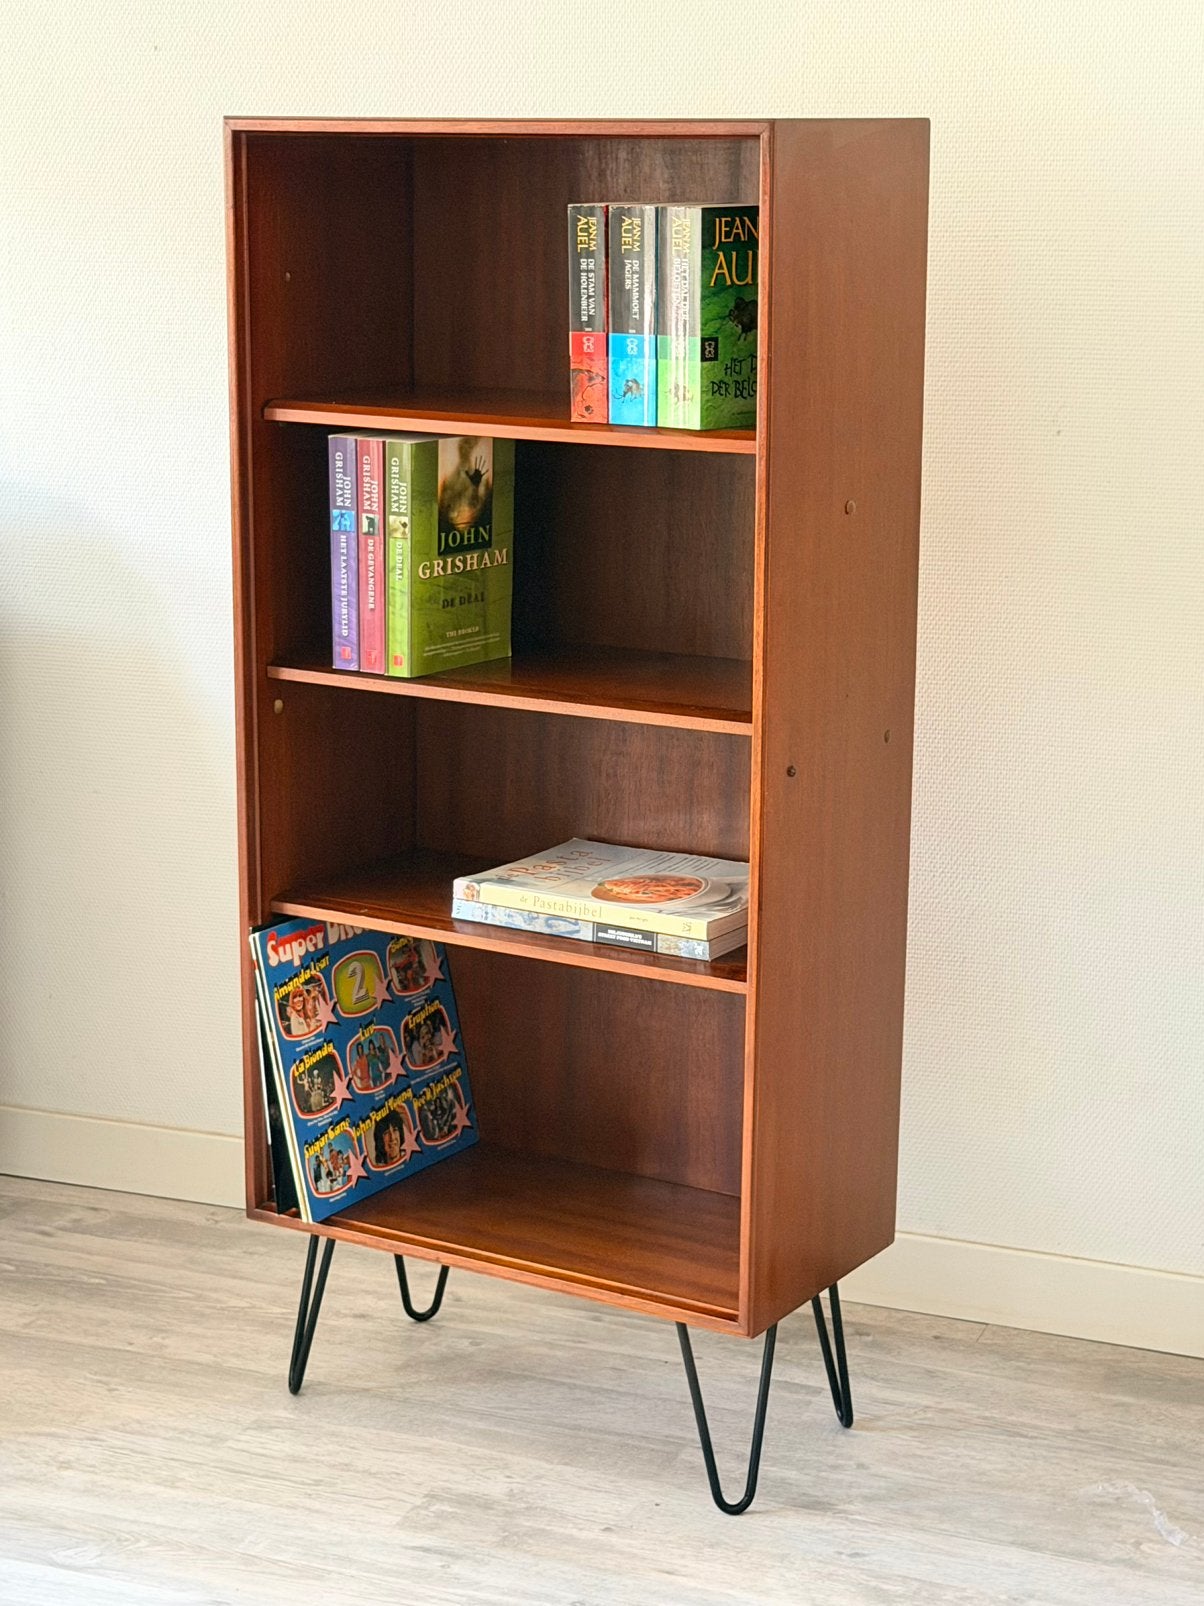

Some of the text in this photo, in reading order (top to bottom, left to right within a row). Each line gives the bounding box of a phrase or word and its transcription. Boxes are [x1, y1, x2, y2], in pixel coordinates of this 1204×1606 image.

[577, 215, 588, 253] AUEL
[587, 216, 597, 251] JEAN M
[621, 215, 632, 254] AUEL
[631, 217, 641, 252] JEAN M
[671, 216, 682, 254] AUEL
[682, 218, 691, 241] JEAN
[588, 258, 595, 270] DE
[624, 260, 632, 290] JAGERS
[580, 258, 588, 322] DE HOLENBEER
[588, 298, 596, 316] VAN
[632, 260, 640, 320] DE MAMMOET
[724, 357, 744, 377] HET
[710, 380, 731, 397] DER
[335, 452, 344, 506] GRISHAM
[343, 476, 352, 507] JOHN
[362, 455, 371, 510] GRISHAM
[370, 480, 379, 512] JOHN
[391, 457, 400, 512] GRISHAM
[399, 482, 408, 513] JOHN
[440, 525, 491, 553] JOHN
[340, 556, 348, 596] LAATSTE
[367, 539, 375, 609] DE GEVANGENE
[418, 548, 508, 579] GRISHAM
[341, 597, 349, 637] JURYLID
[507, 850, 594, 876] Pasta
[532, 895, 603, 919] Pastabijbel
[266, 928, 325, 967] Super
[274, 966, 312, 1000] Amanda
[347, 961, 370, 1006] 2
